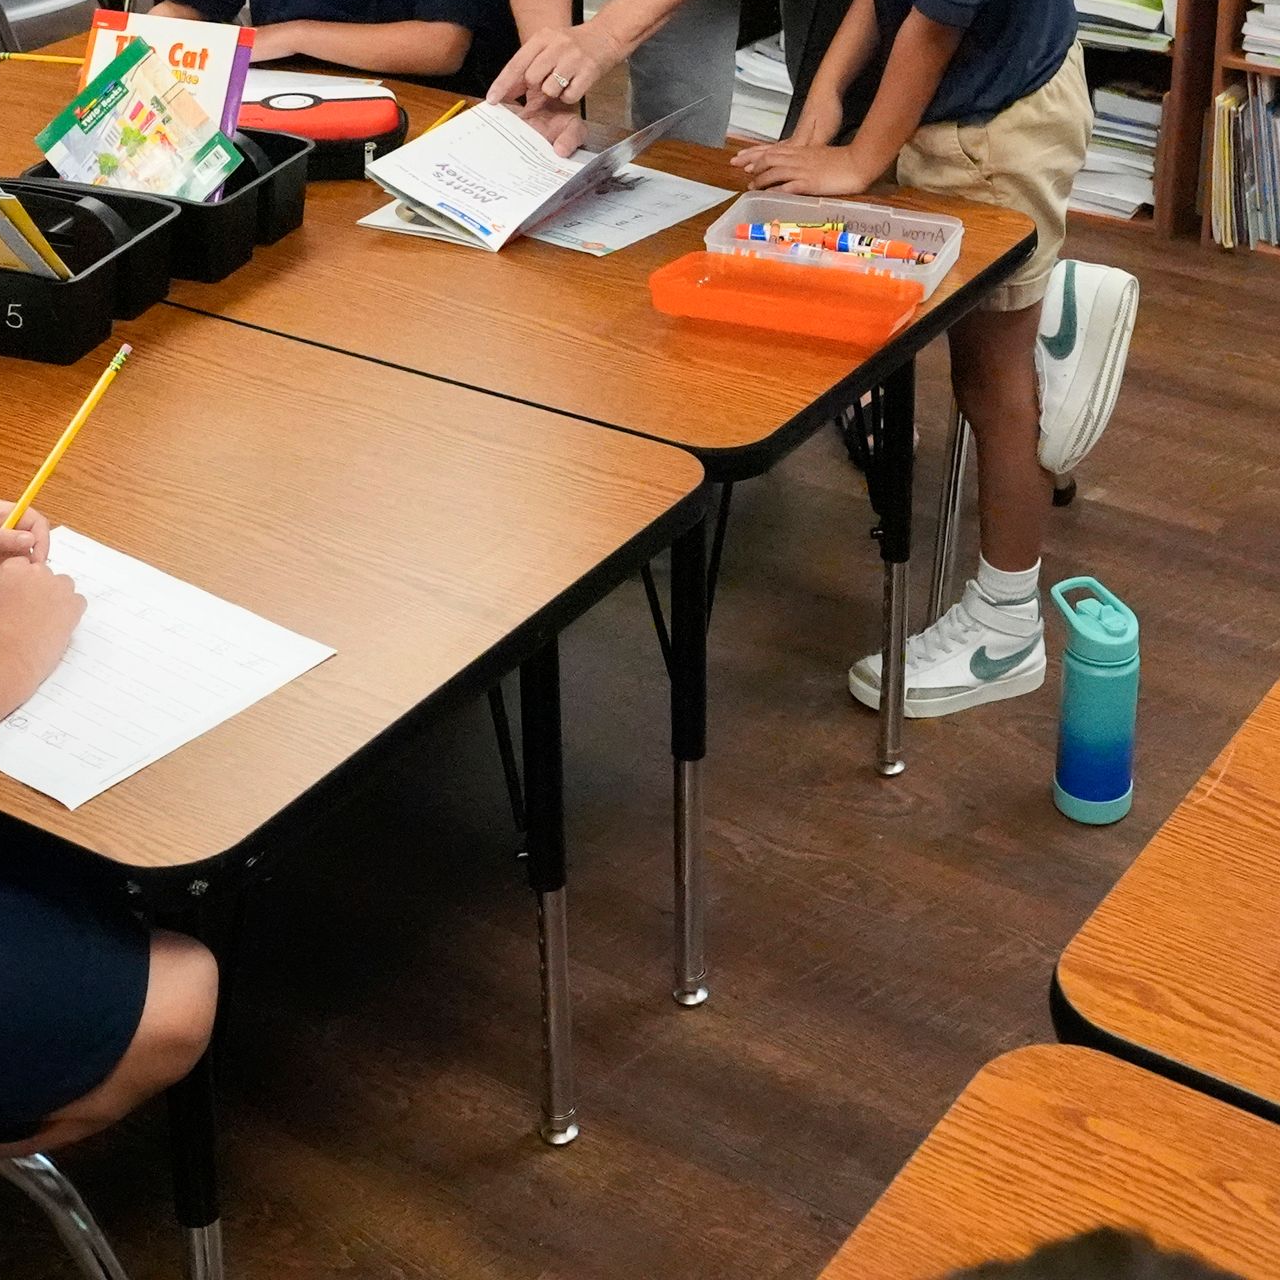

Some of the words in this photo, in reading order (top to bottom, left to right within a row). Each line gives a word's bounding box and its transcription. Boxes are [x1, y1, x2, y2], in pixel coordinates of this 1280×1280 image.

[168, 42, 210, 70] Cat
[431, 170, 494, 205] Matt's
[435, 162, 508, 203] Journey
[5, 303, 24, 329] 5
